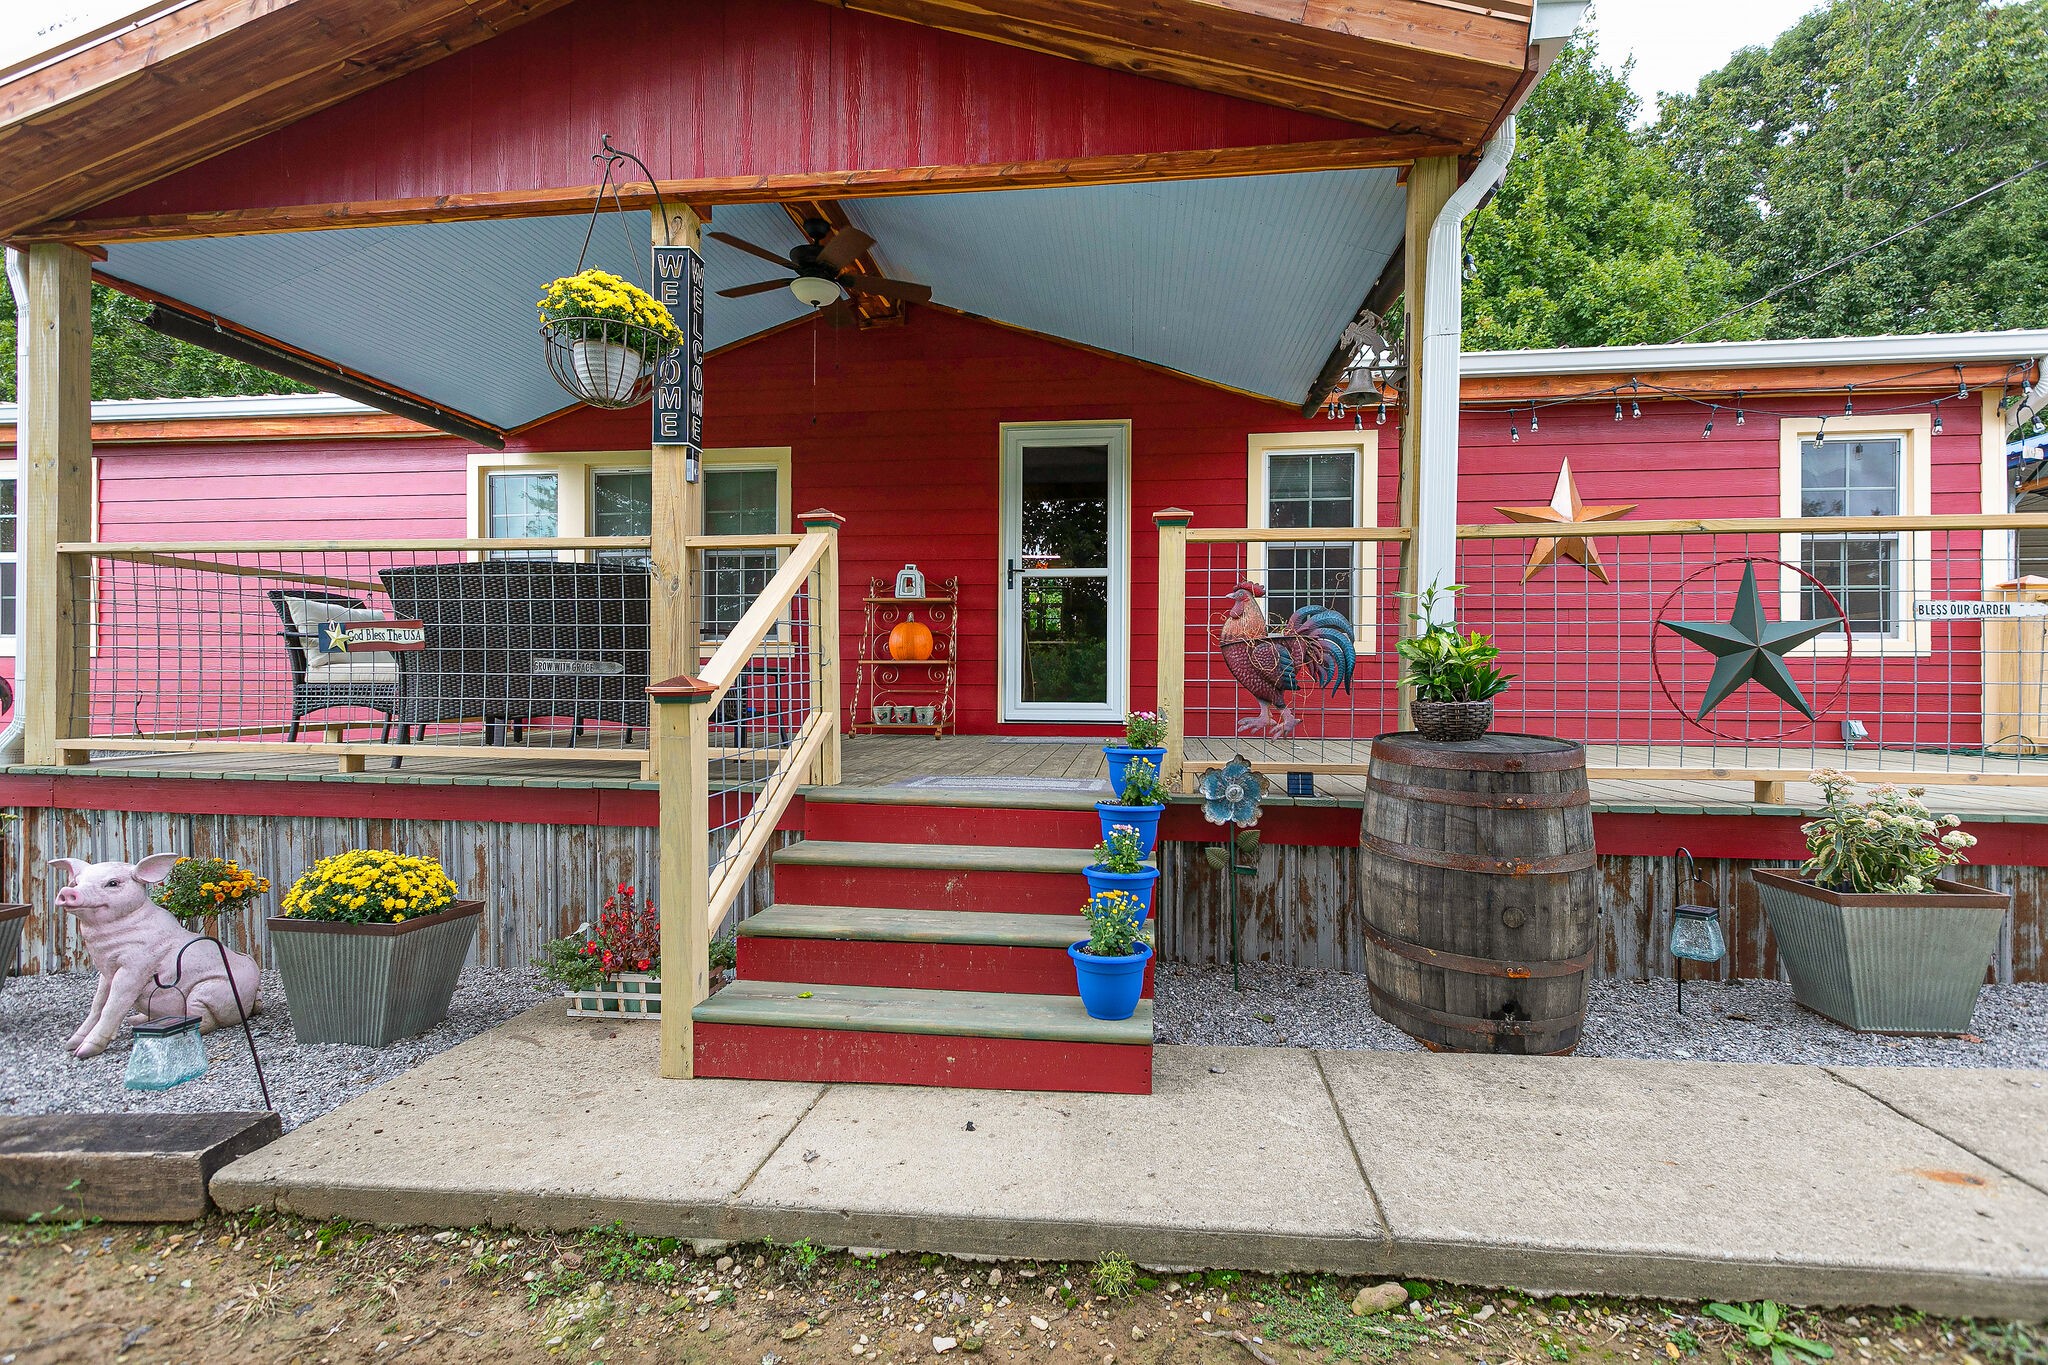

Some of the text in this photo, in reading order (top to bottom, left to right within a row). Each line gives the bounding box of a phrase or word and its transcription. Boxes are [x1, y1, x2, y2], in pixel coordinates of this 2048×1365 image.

[657, 253, 684, 438] WEOME
[691, 257, 705, 442] WELCOME
[1918, 604, 2011, 615] BLESS OUR GARDEN
[347, 628, 421, 642] God Bless The USA
[533, 661, 594, 673] GROW WITH GRACE
